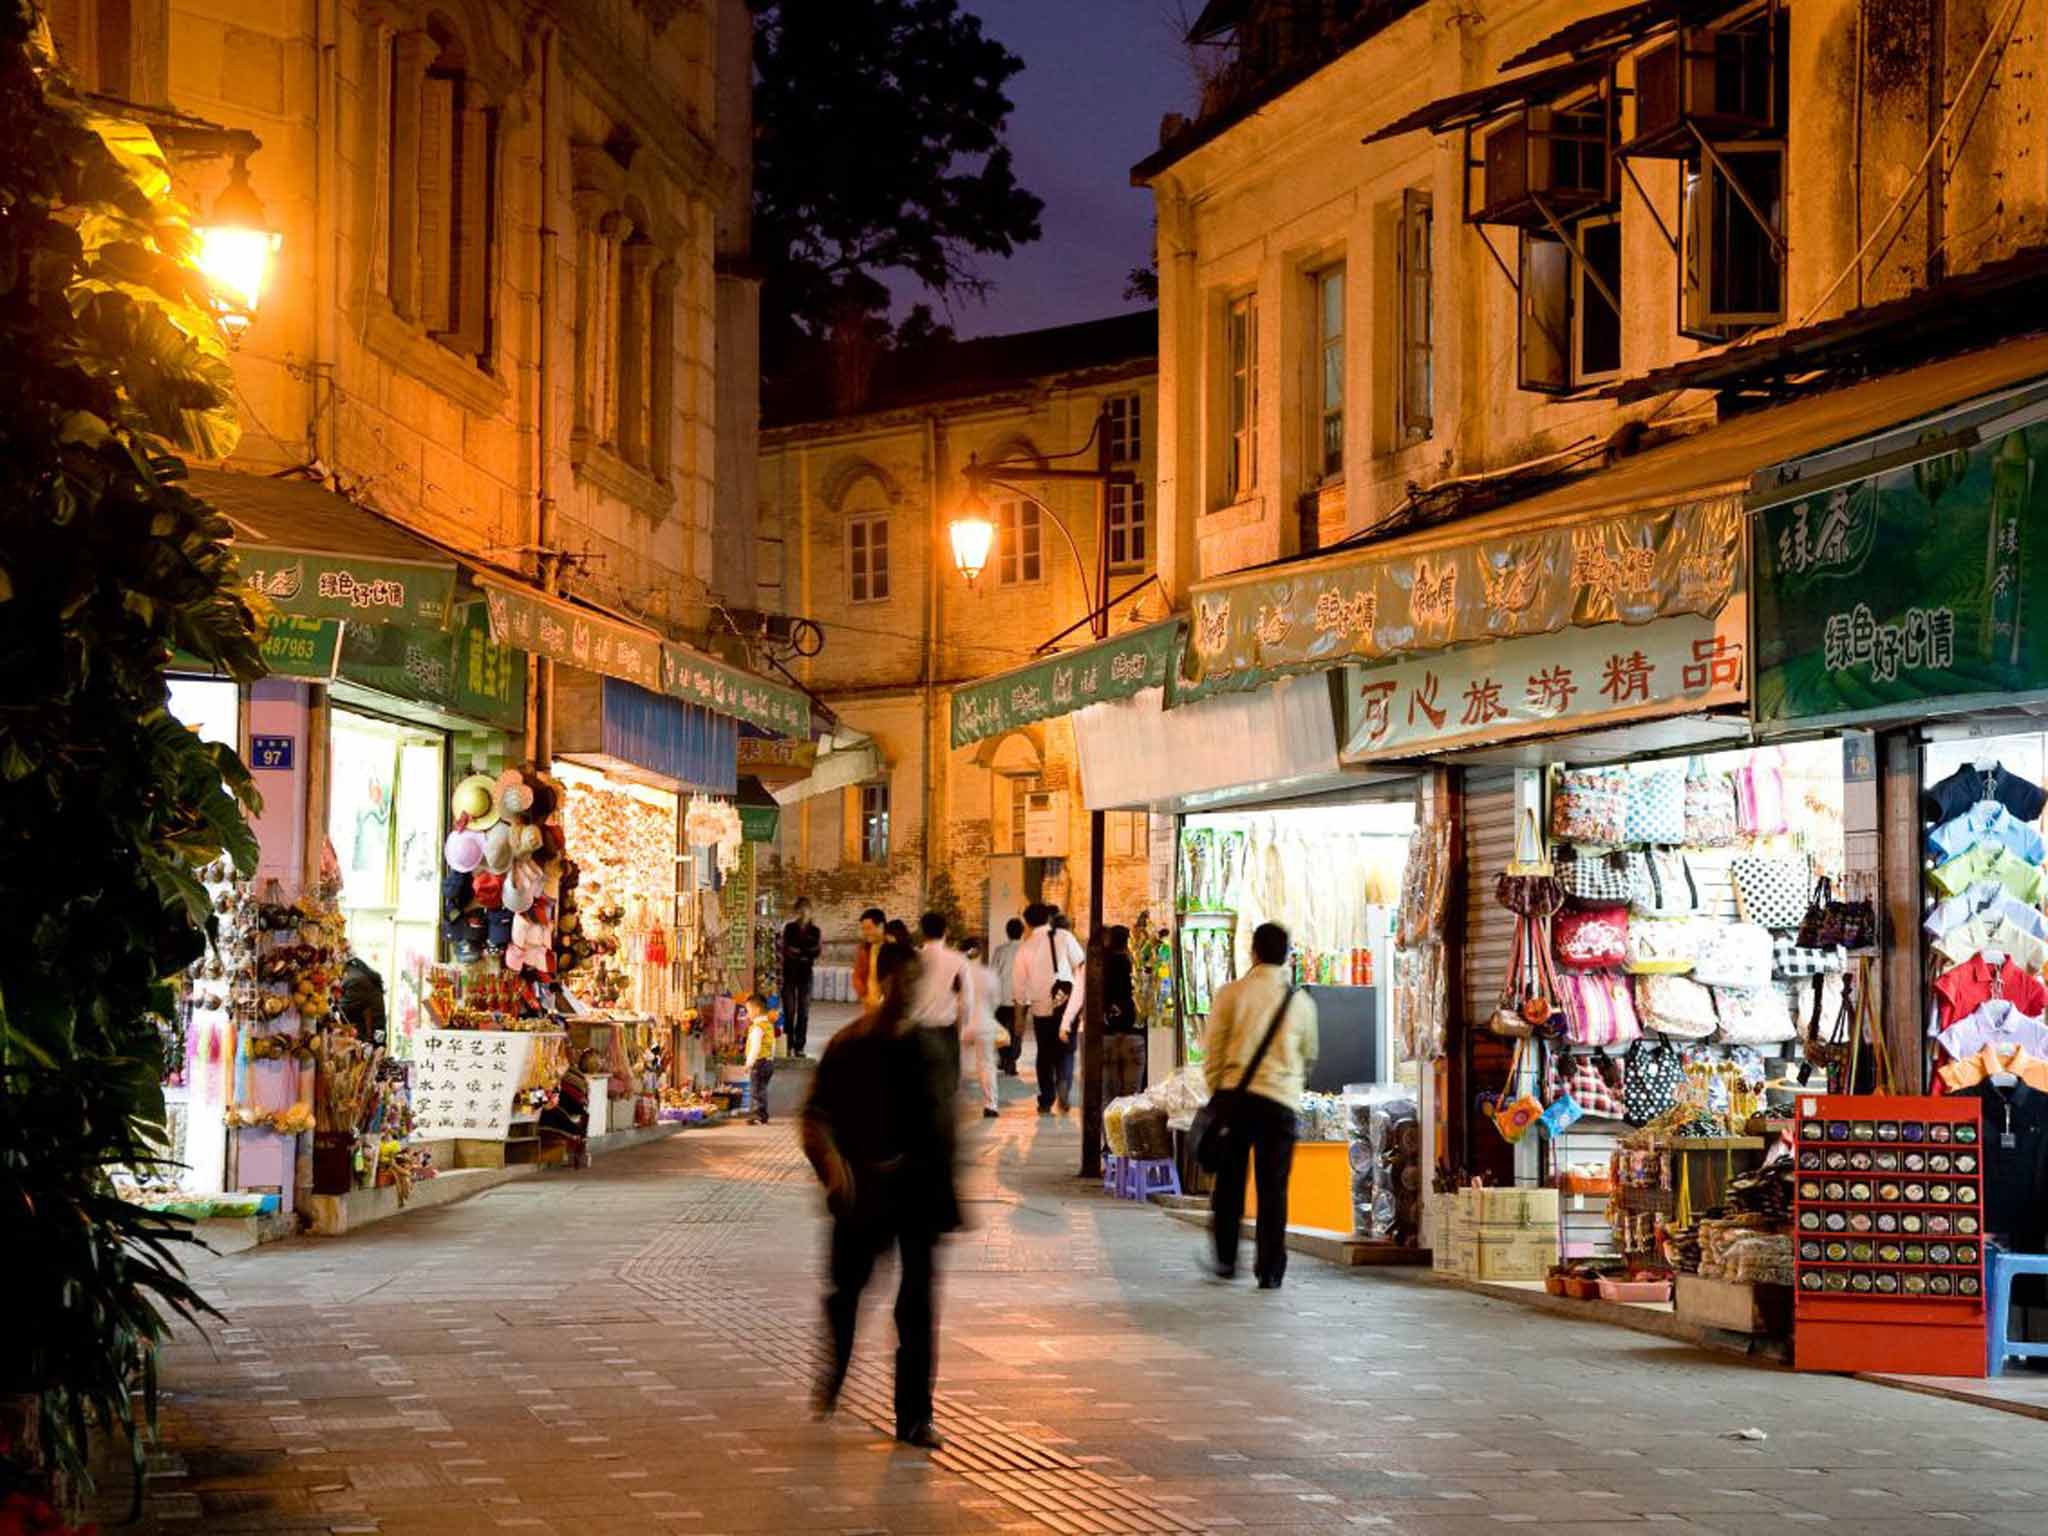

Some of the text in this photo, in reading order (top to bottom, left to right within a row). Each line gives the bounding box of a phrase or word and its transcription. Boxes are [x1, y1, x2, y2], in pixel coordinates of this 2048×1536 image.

[319, 571, 404, 608] 绿色好心情
[1824, 602, 1953, 683] 绿色好心情
[1360, 635, 1737, 740] 可心旅游精品
[263, 750, 281, 766] 97
[424, 1035, 508, 1056] 中华艺术
